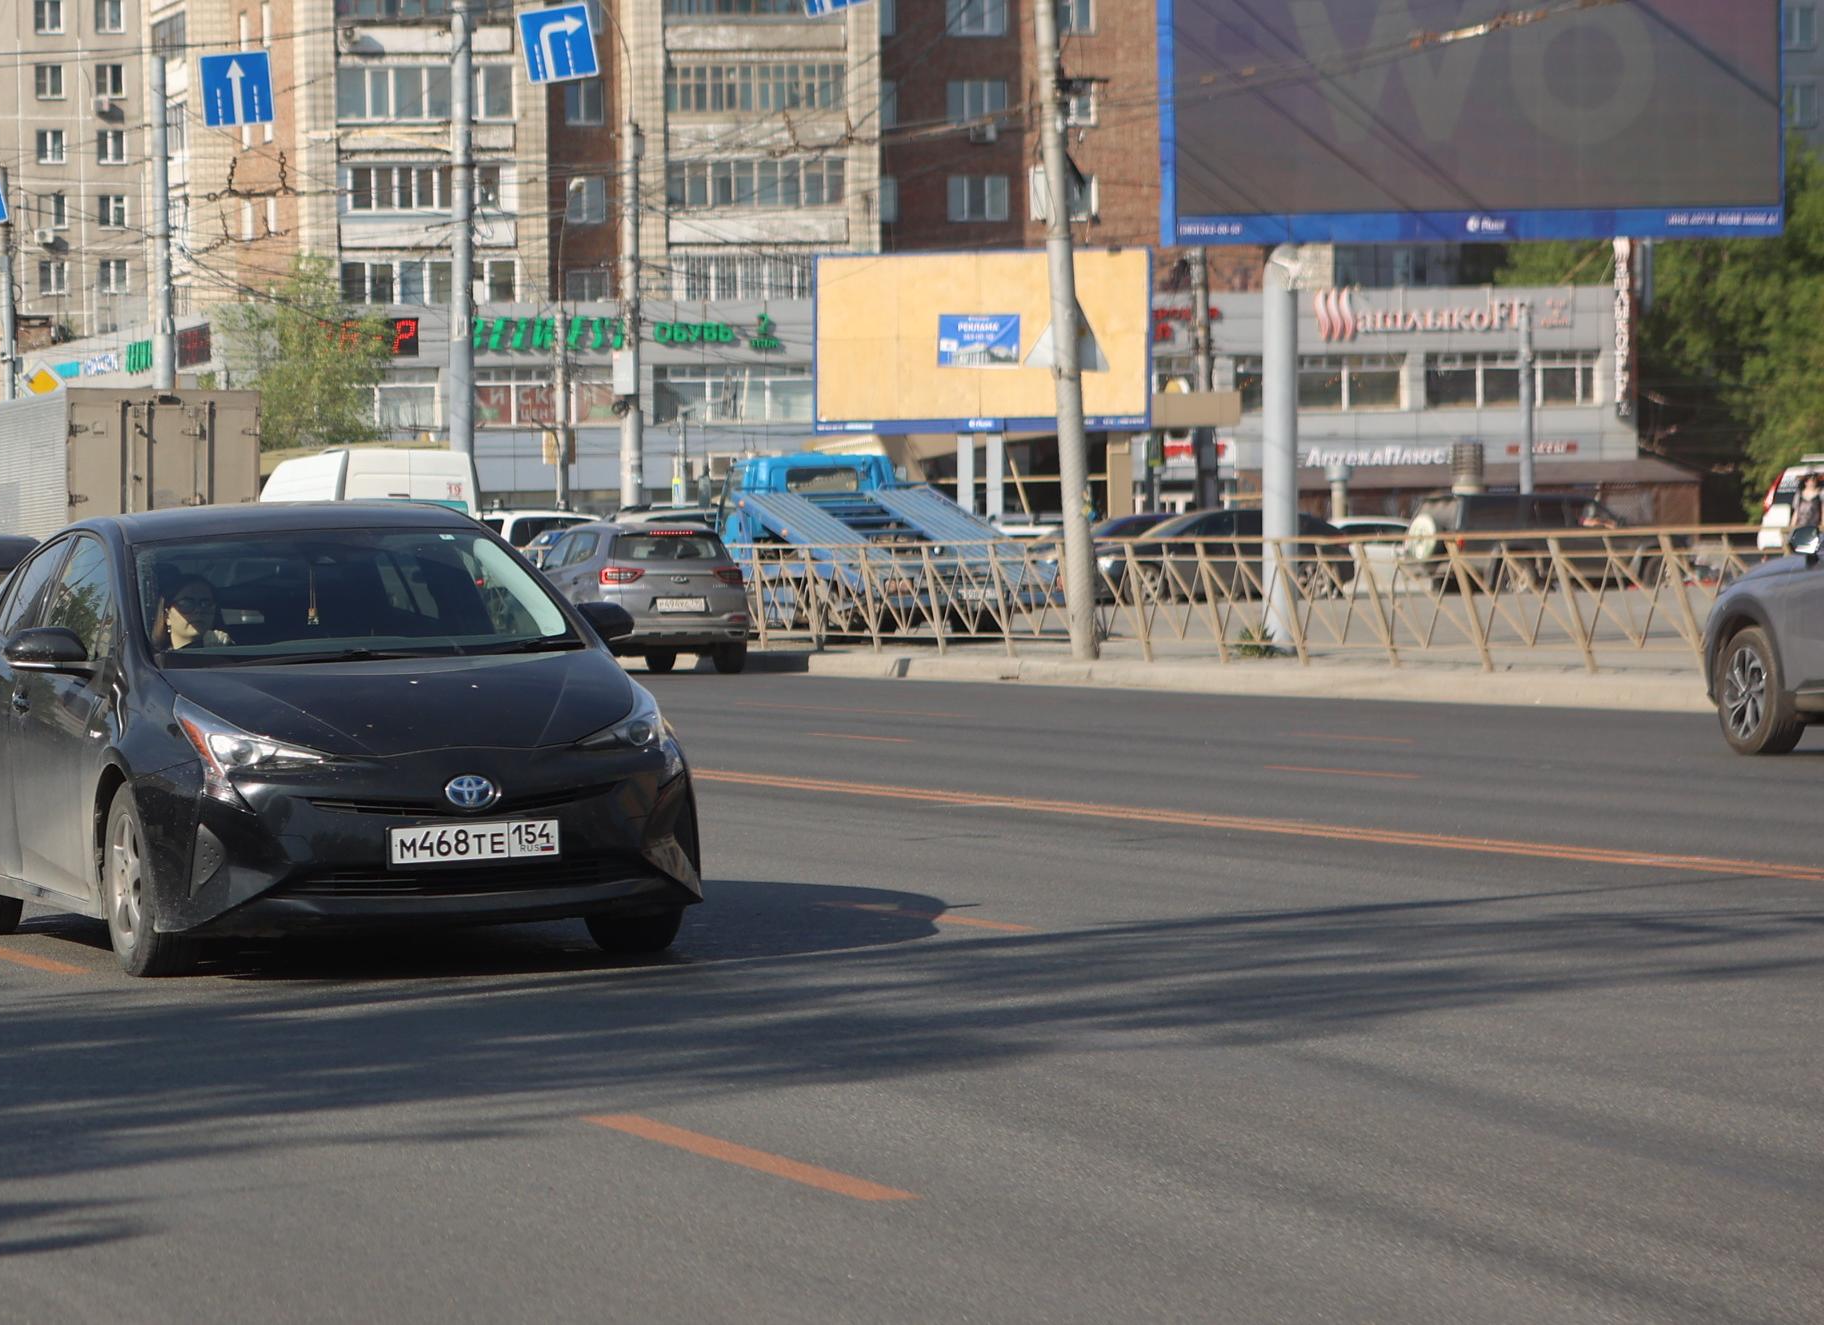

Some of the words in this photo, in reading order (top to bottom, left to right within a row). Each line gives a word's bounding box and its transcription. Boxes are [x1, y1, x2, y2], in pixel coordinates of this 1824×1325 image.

[653, 321, 734, 343] ОБУВЬ
[957, 321, 1000, 332] РЕКЛАМА
[399, 830, 505, 859] М468ТЕ
[511, 822, 551, 845] 154
[519, 844, 540, 853] RUS
